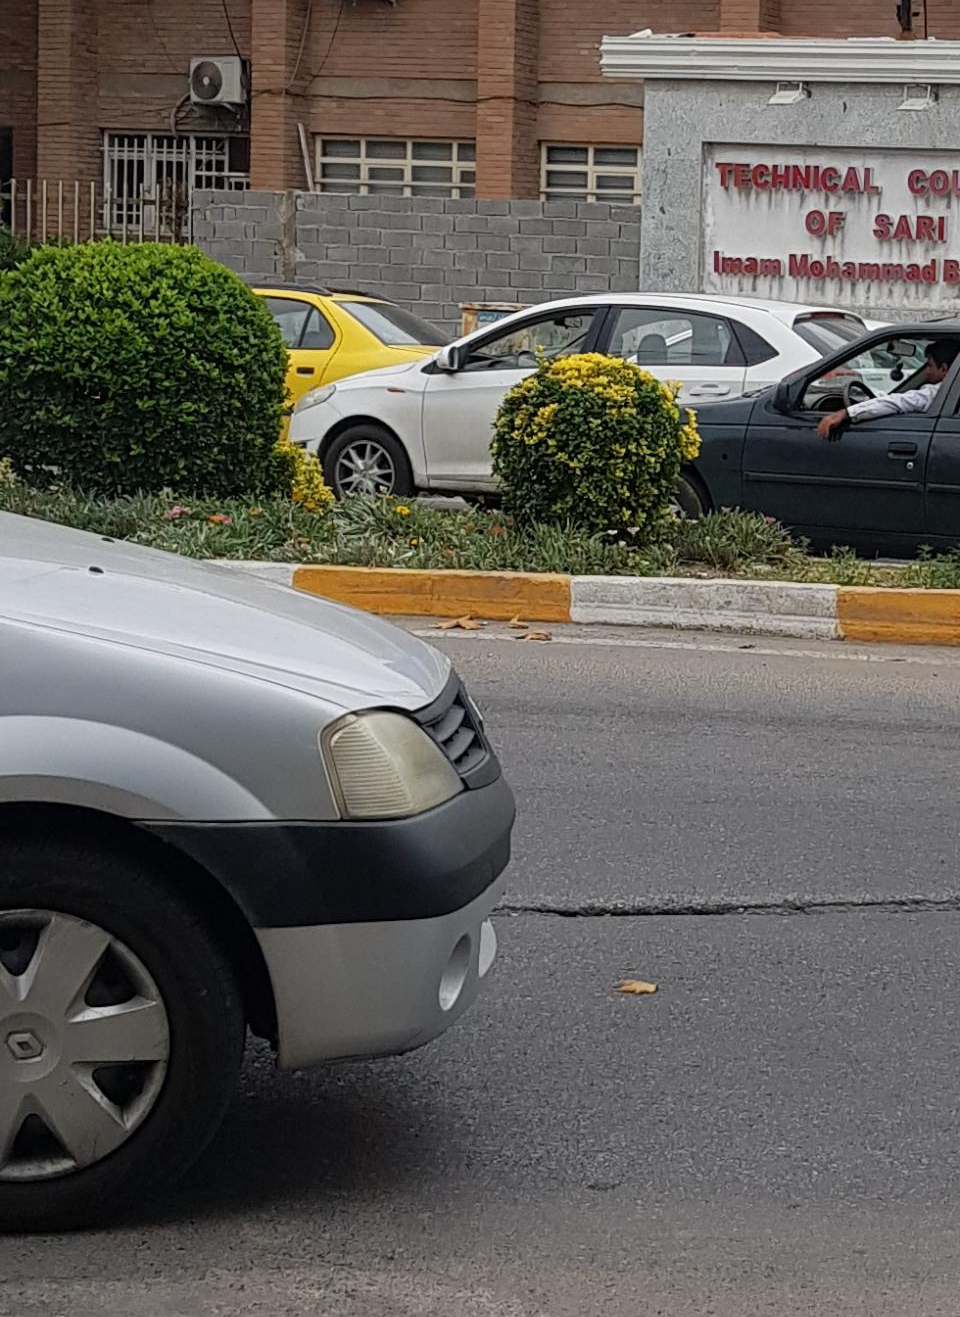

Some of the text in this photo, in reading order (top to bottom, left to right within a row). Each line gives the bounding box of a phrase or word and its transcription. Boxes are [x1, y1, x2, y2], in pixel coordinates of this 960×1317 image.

[714, 162, 882, 195] TECHNICAL
[805, 209, 947, 243] OF SARI
[713, 250, 783, 278] Imam
[787, 253, 938, 285] Mohammad
